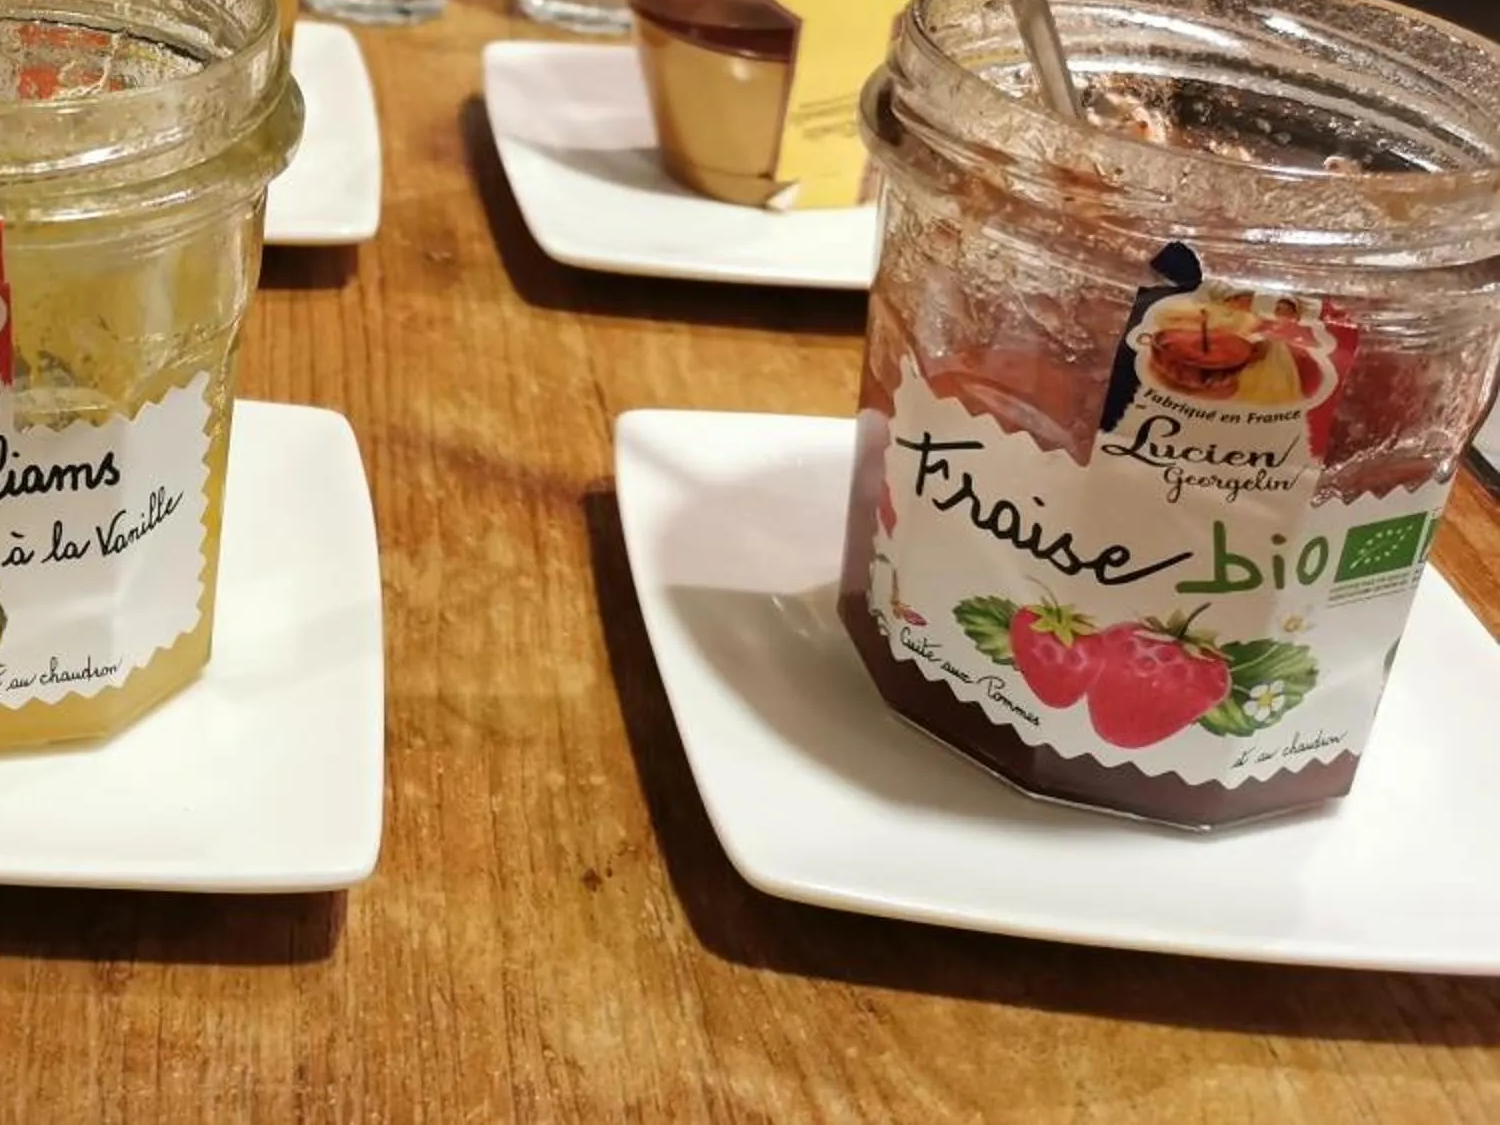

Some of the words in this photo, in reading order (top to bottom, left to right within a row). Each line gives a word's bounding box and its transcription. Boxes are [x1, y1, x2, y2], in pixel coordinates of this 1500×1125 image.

[1143, 388, 1219, 420] Fabriqué
[1220, 412, 1241, 424] en
[1247, 409, 1300, 424] France
[1101, 415, 1300, 468] Lucien
[1162, 466, 1300, 504] Georgelin
[1, 532, 34, 567] à
[41, 522, 90, 563] la
[93, 487, 185, 557] Vanille
[895, 431, 1196, 588] Fraise
[1175, 520, 1329, 594] bio
[6, 673, 36, 691] au
[39, 654, 123, 686] chaudron
[900, 626, 943, 662] Cuite
[976, 675, 1041, 726] Pommes
